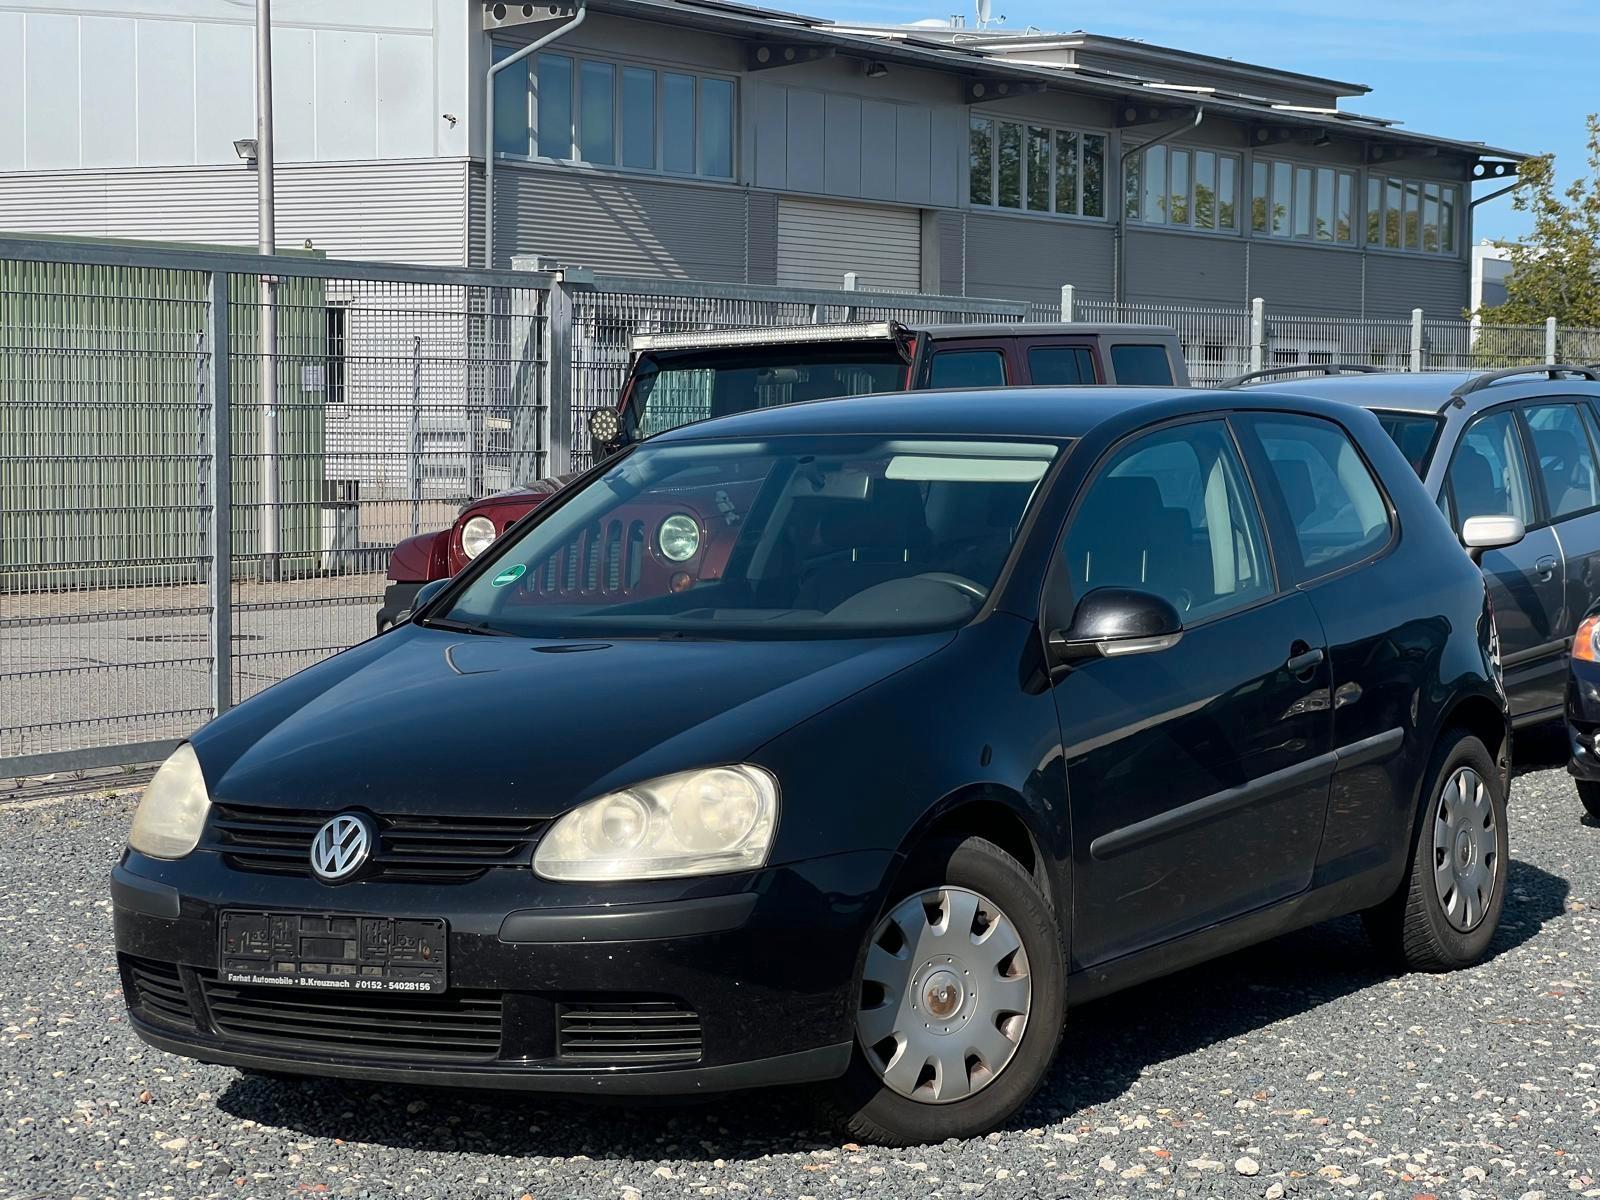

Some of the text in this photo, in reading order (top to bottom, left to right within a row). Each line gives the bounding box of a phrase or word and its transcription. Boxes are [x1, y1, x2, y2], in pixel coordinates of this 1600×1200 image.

[312, 815, 367, 878] VW
[228, 973, 251, 982] Farhat
[252, 975, 294, 985] Automobile
[361, 980, 383, 989] 0152
[388, 981, 431, 991] 54028156
